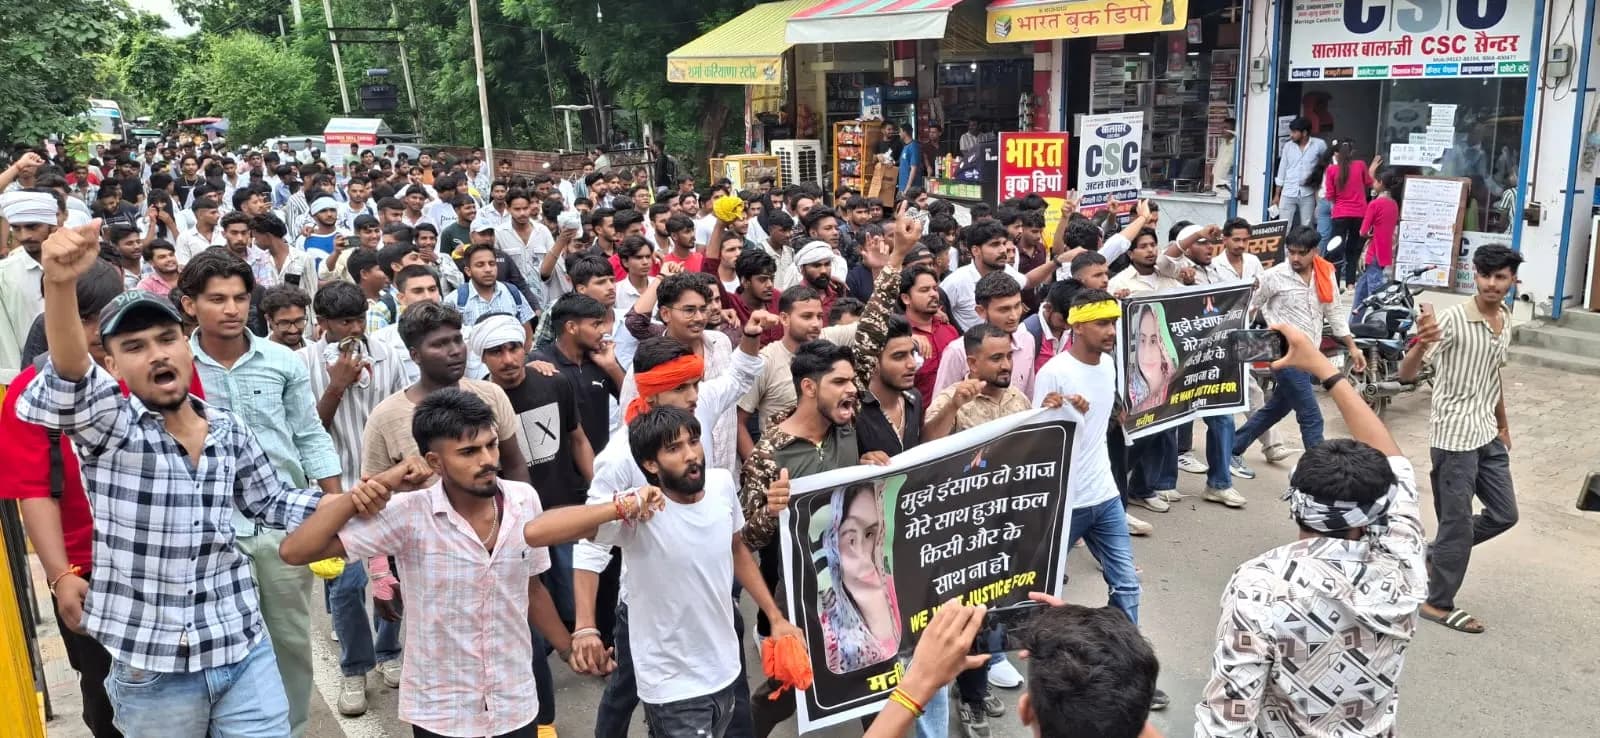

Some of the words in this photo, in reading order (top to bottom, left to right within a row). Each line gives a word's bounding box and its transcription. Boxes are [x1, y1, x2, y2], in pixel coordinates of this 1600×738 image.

[1017, 15, 1061, 32] भारत
[1063, 9, 1101, 33] बुक
[1104, 1, 1152, 25] डिपो
[1312, 42, 1360, 59] सालासर
[1421, 34, 1467, 55] CSC
[1474, 31, 1520, 53] सैन्टर
[1006, 138, 1064, 168] भारत
[1085, 141, 1138, 177] CSC
[1005, 175, 1031, 199] बुक
[1031, 170, 1063, 193] डिपो
[1169, 315, 1192, 337] मुझे
[1192, 315, 1224, 331] इंसाफ
[1181, 337, 1199, 352] मेरे
[1215, 346, 1226, 359] के
[1207, 365, 1220, 380] हो
[1220, 381, 1238, 393] FOR
[901, 484, 934, 516] मुझे
[936, 473, 990, 503] इंसाफ
[991, 462, 1014, 484] दो
[1014, 461, 1057, 481] आज
[904, 518, 932, 541] मेरे
[934, 509, 970, 532] साथ
[972, 497, 1008, 526] हुआ
[1011, 491, 1050, 511] कल
[920, 534, 963, 568] किसी
[966, 526, 1002, 552] और
[1003, 522, 1024, 541] के
[932, 569, 966, 596] साथ
[968, 560, 988, 580] ना
[989, 552, 1011, 574] हो
[910, 609, 929, 633] WE
[965, 578, 1012, 609] JUSTICE
[1010, 571, 1037, 589] FOR
